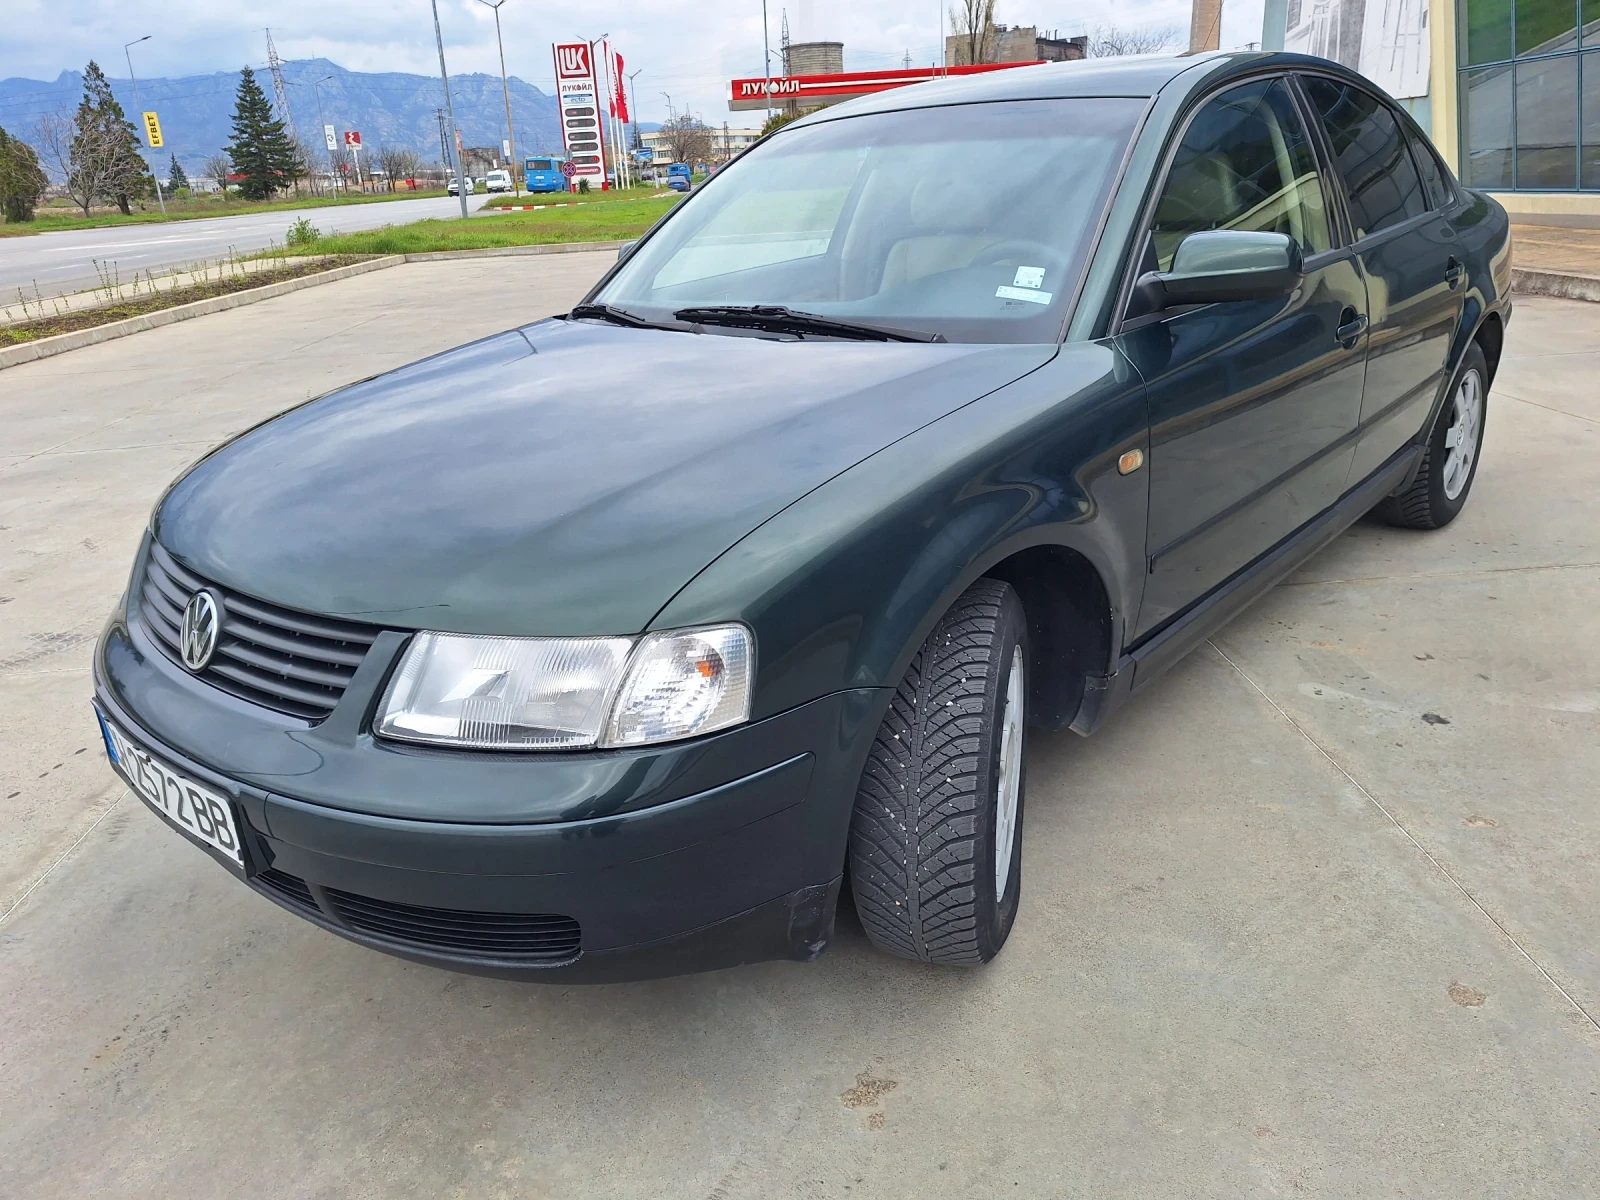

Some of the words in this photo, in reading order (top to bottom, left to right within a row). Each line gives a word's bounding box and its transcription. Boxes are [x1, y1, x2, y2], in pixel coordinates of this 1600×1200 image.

[562, 83, 593, 92] ЛУКОЙЛ
[741, 77, 800, 96] ЛУКОЙЛ
[147, 115, 160, 145] EFBET
